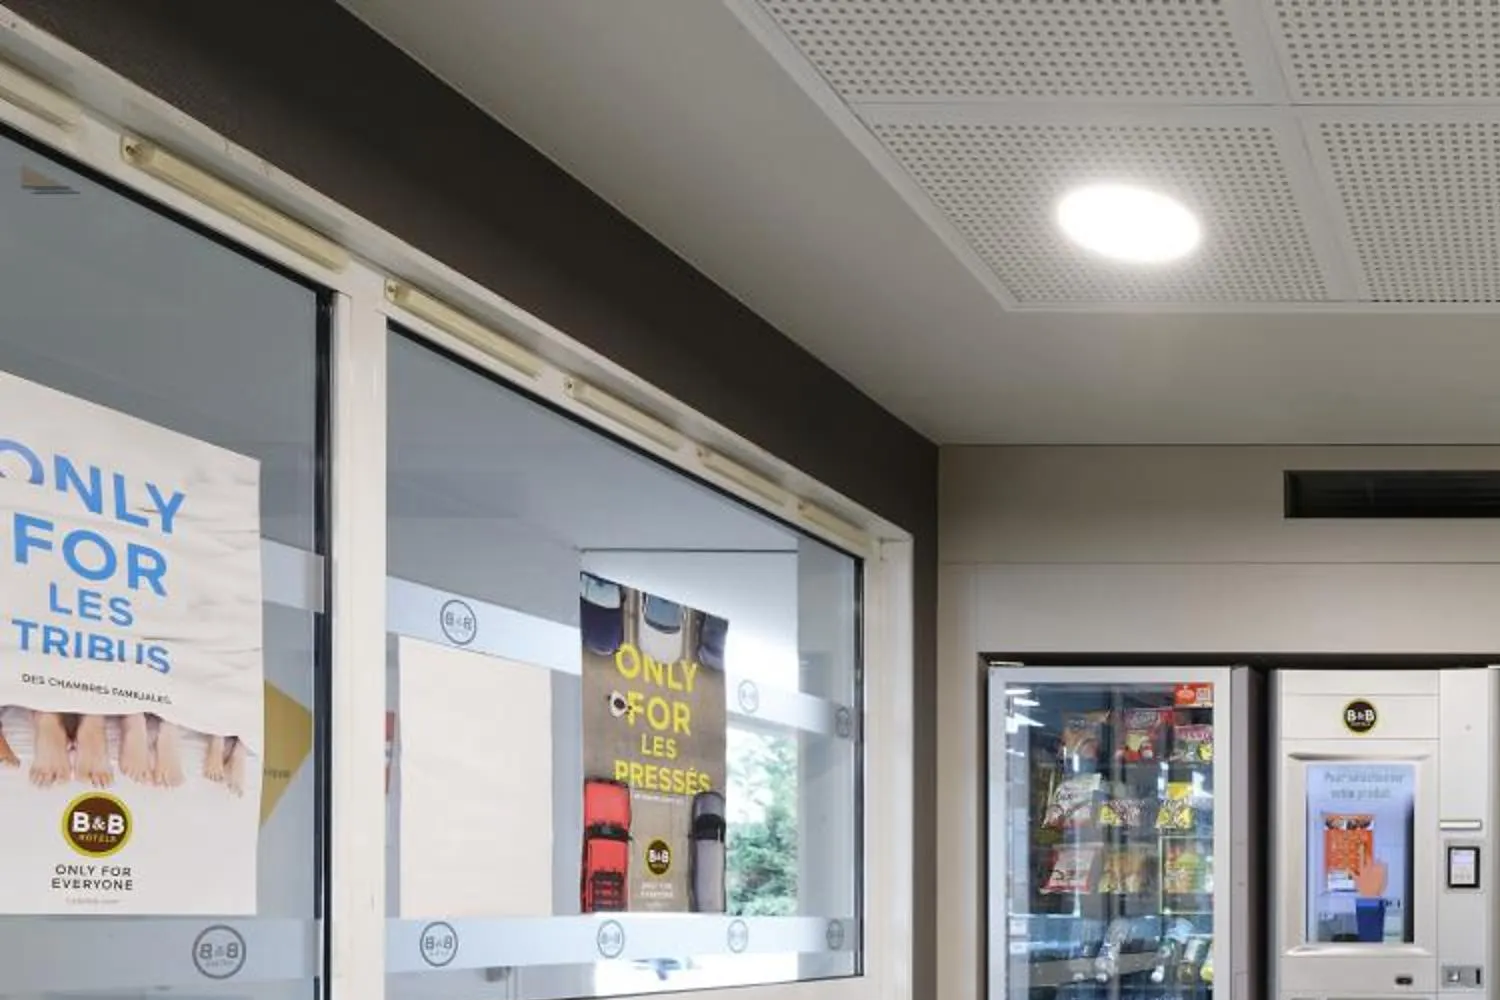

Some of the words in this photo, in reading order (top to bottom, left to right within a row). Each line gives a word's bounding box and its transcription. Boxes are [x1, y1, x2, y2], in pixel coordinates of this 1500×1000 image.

[13, 512, 168, 597] FOR
[49, 582, 134, 627] LES
[11, 618, 171, 674] TRIBUS
[21, 673, 45, 685] DES
[615, 643, 698, 693] ONLY
[627, 690, 692, 736] FOR
[641, 733, 678, 760] LES
[72, 811, 125, 835] B&B
[51, 877, 133, 890] EVERYONE
[55, 864, 95, 876] ONLY
[101, 865, 131, 877] FOR
